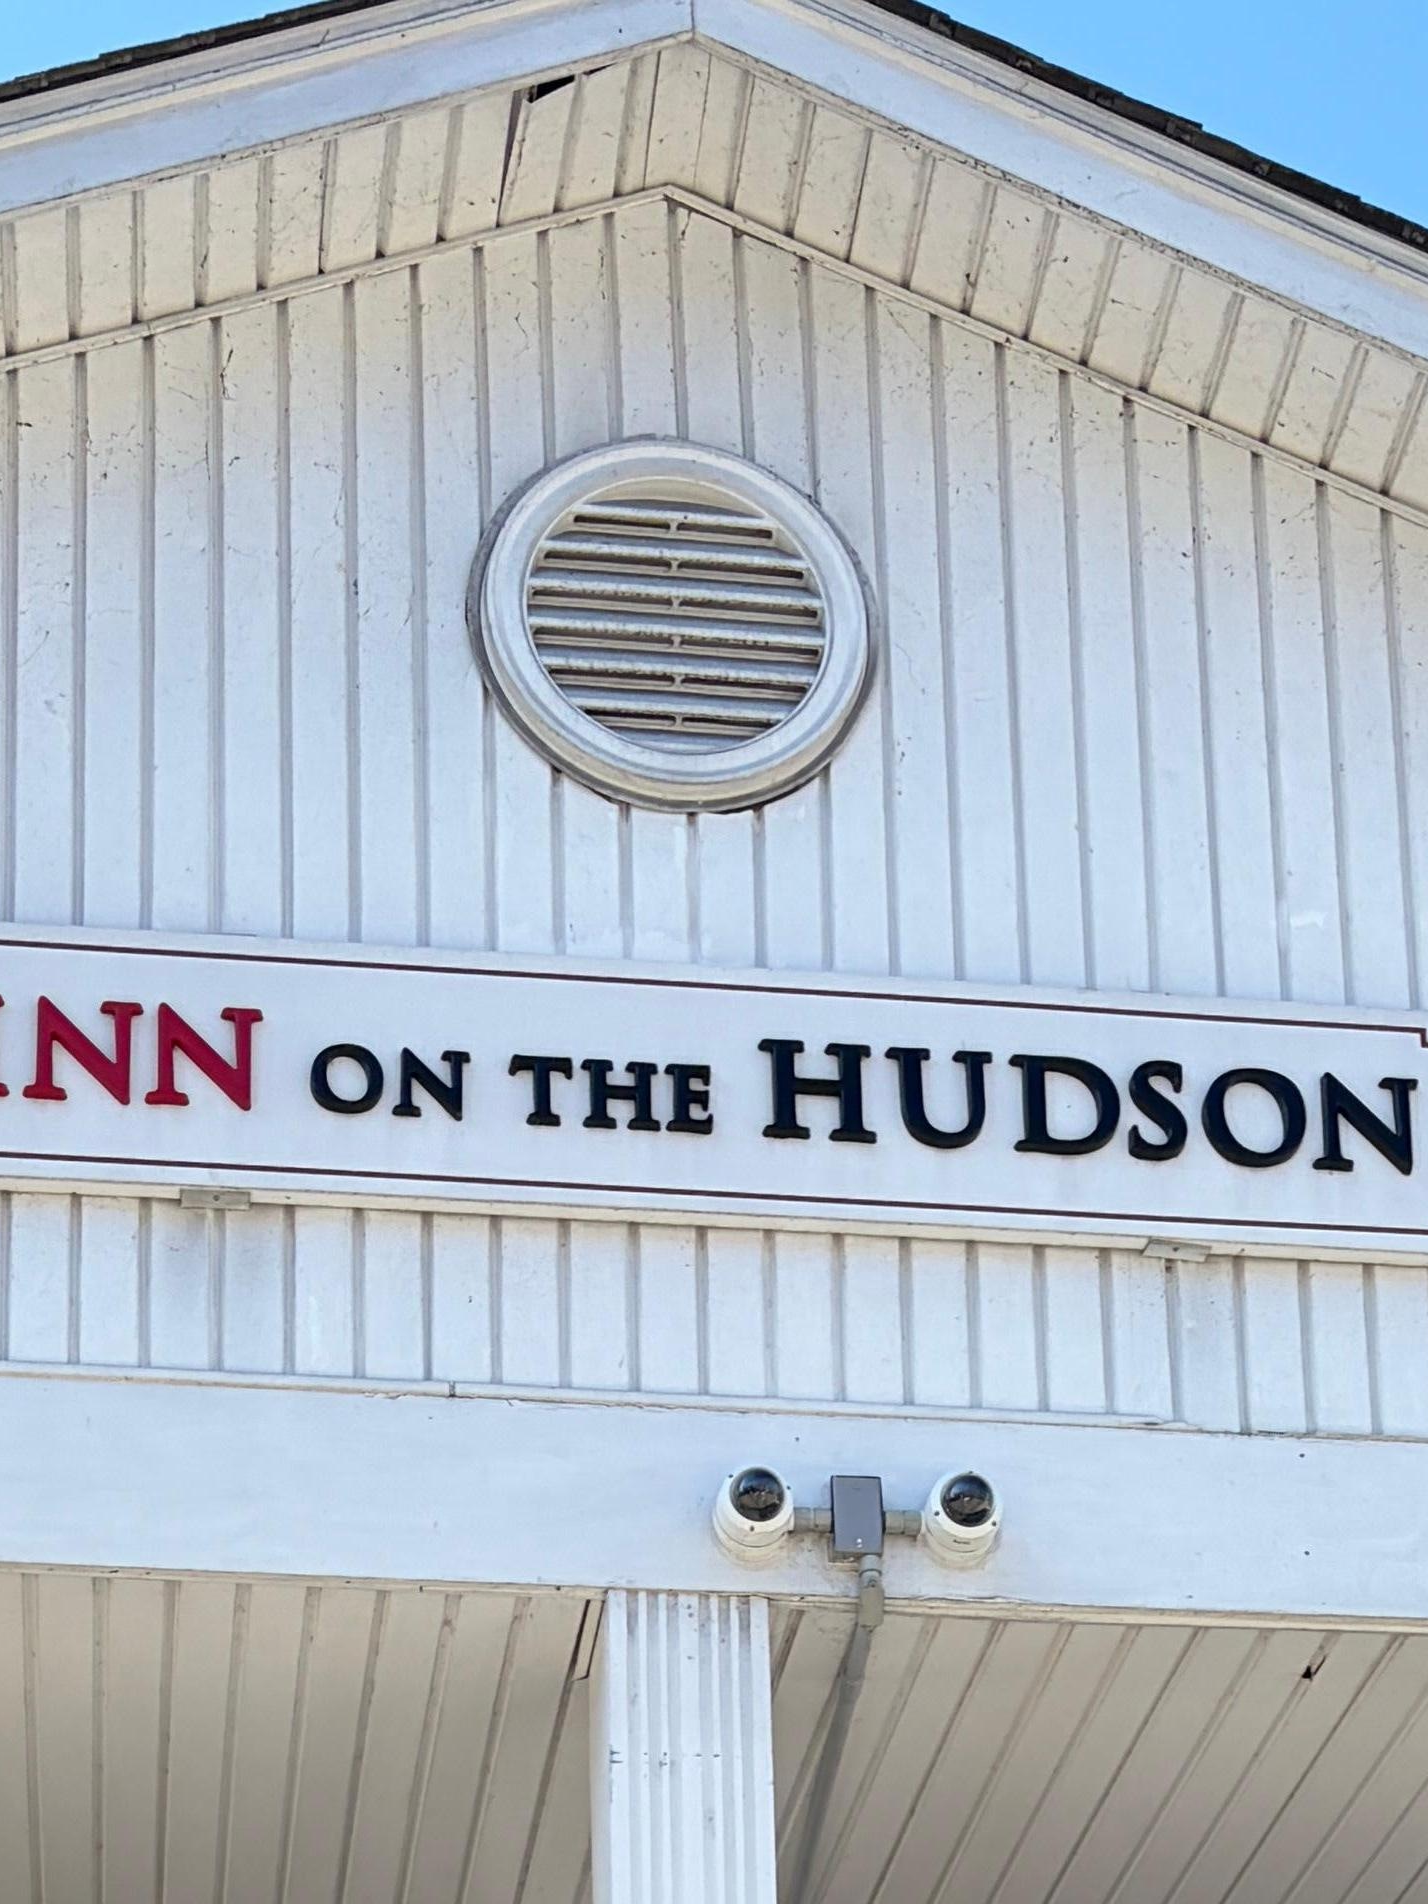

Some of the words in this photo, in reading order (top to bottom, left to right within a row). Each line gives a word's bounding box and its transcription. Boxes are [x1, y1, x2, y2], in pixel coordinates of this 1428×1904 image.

[310, 1044, 470, 1121] ON
[508, 1054, 713, 1135] THE
[758, 1039, 1418, 1175] HUDSON
